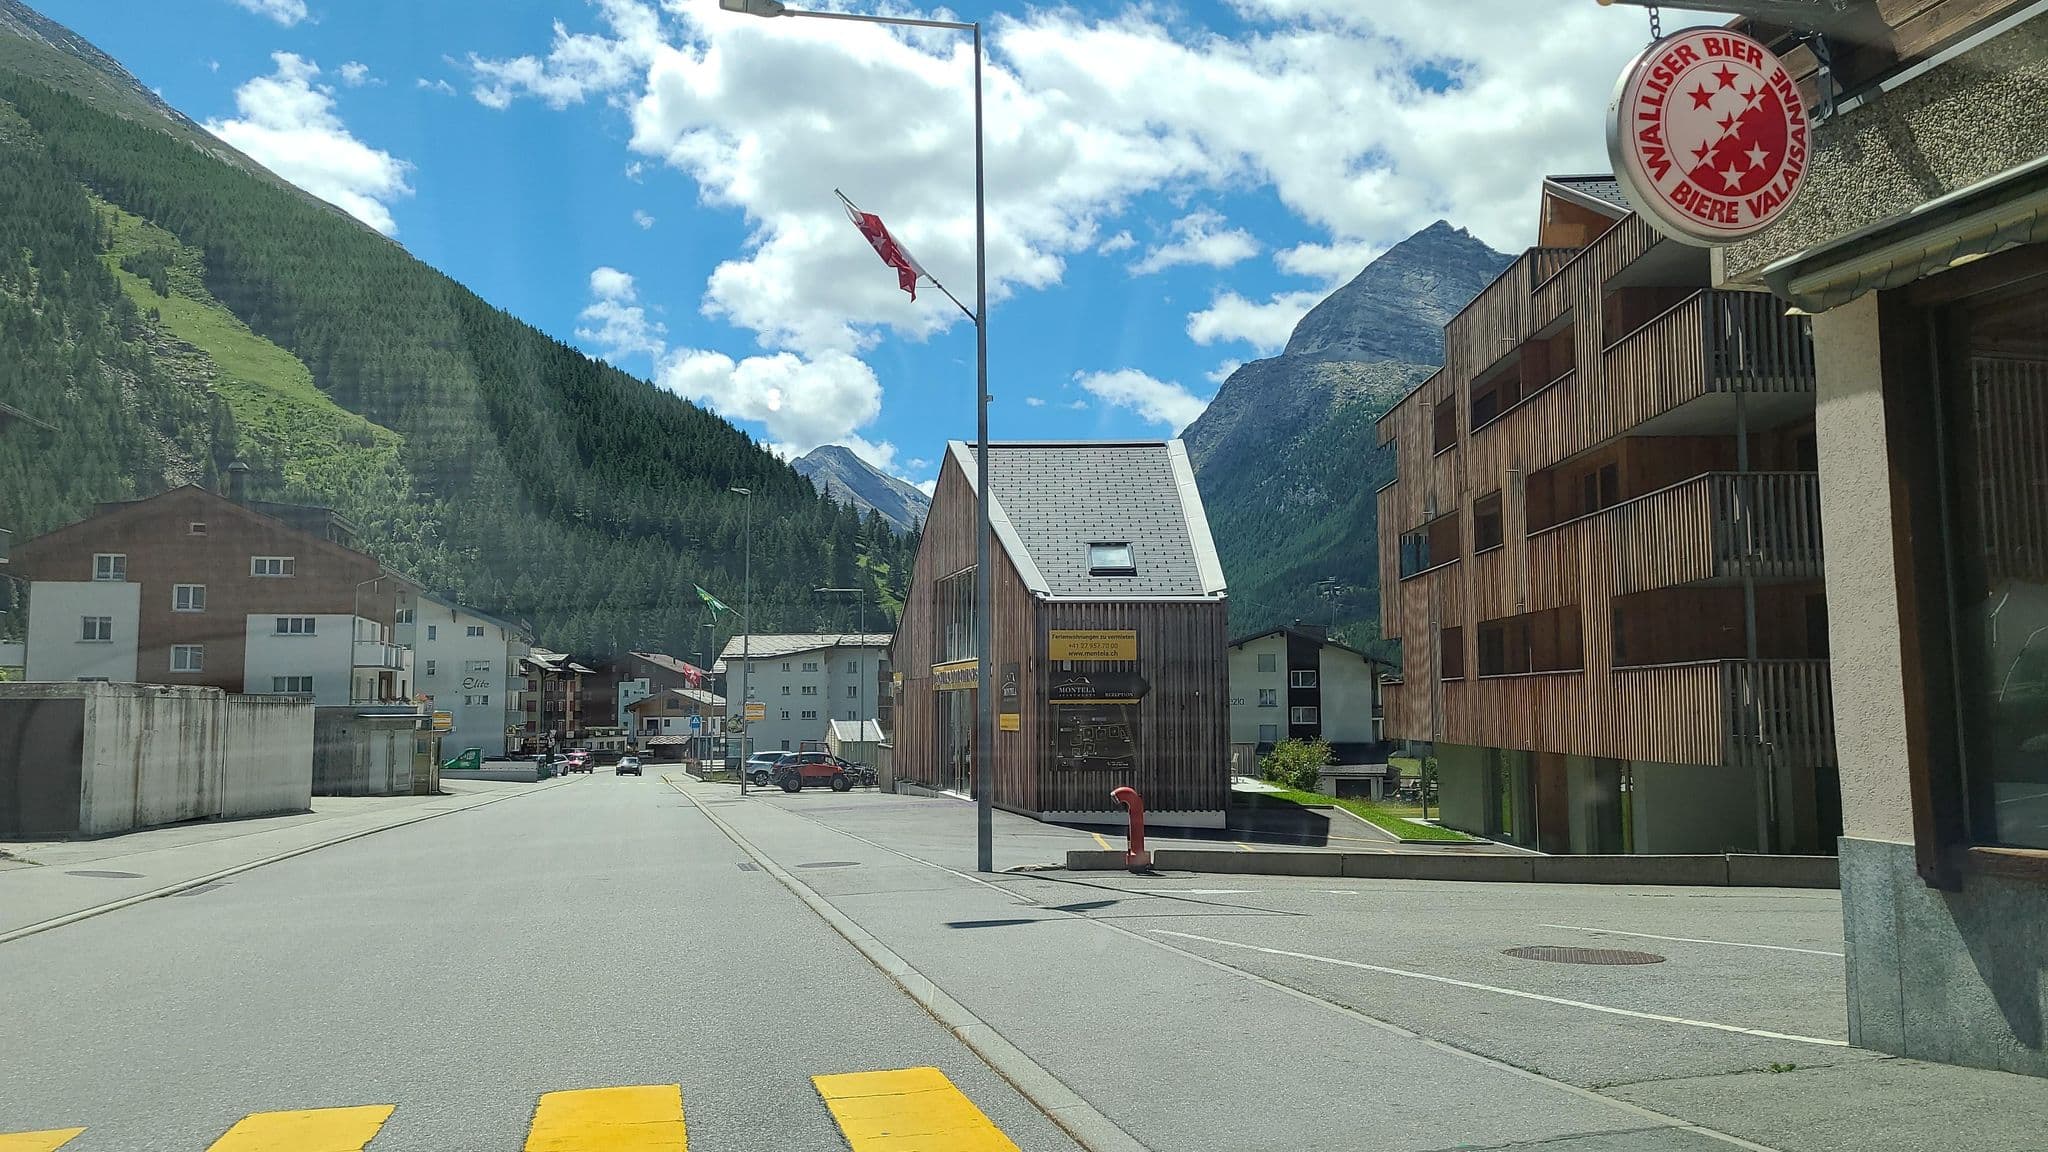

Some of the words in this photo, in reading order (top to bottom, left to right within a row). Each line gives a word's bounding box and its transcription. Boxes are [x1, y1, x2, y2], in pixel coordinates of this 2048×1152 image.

[1638, 44, 1701, 182] WALLISER
[1702, 37, 1764, 70] BIER
[1669, 180, 1739, 224] BIERE
[1745, 66, 1807, 219] VALAISANNE
[462, 677, 490, 690] Elite
